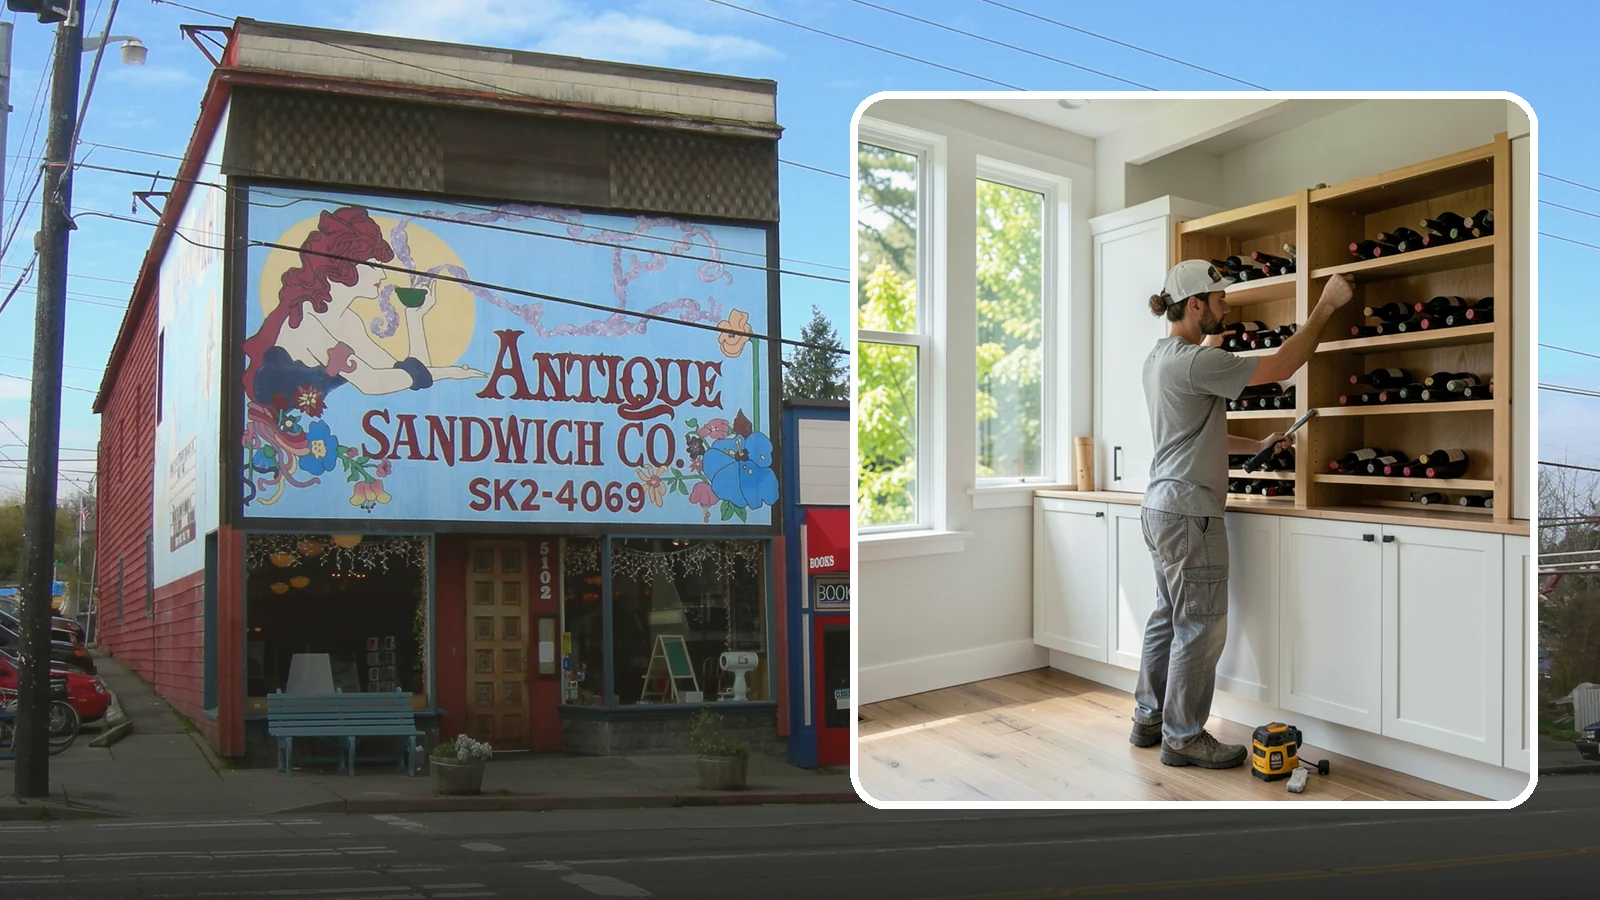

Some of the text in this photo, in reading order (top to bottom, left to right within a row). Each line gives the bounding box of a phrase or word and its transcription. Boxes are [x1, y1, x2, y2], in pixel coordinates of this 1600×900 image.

[475, 329, 723, 420] ANTIQUE
[361, 409, 685, 469] SANDWICH CO.
[468, 478, 646, 513] SK2-4069
[539, 542, 551, 599] 5102
[809, 555, 835, 569] BOOKS
